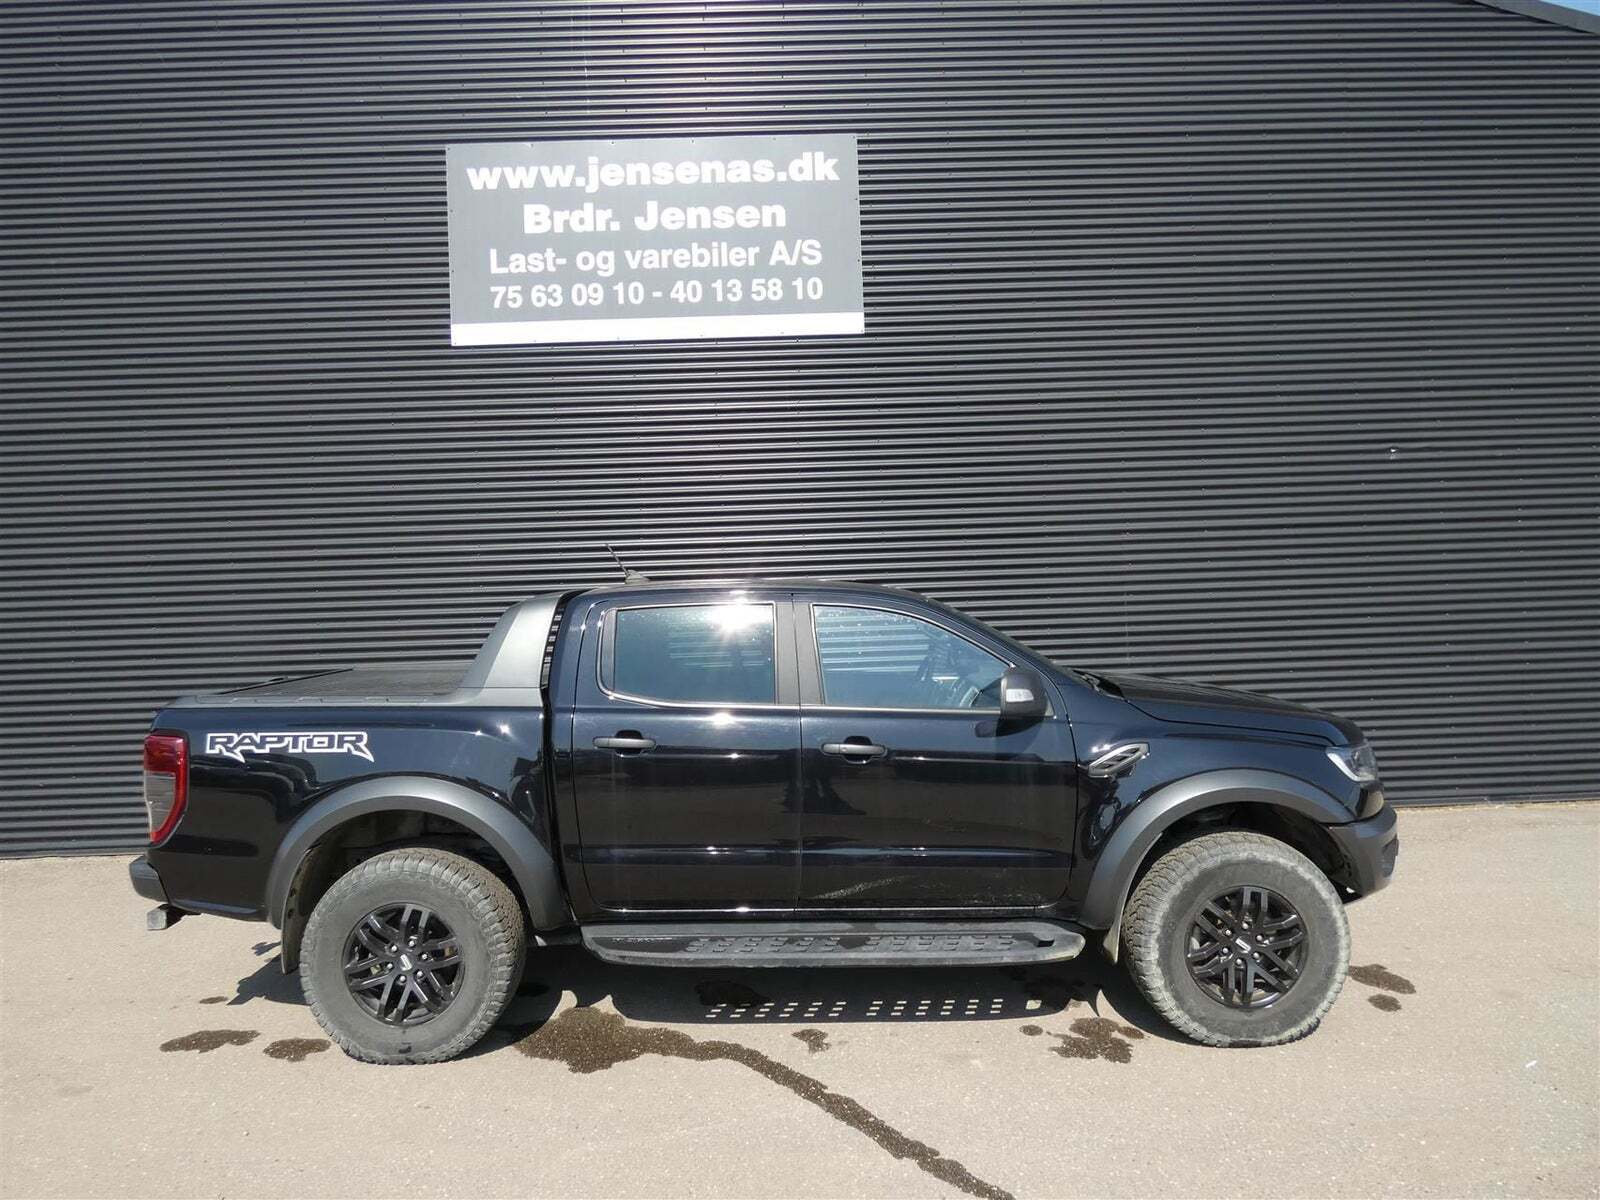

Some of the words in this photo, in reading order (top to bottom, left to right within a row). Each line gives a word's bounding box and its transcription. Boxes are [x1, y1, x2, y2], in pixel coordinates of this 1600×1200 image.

[466, 151, 841, 193] www.jensenas.dk
[523, 202, 621, 234] Brdr.
[634, 200, 787, 231] Jensen
[489, 247, 567, 274] Last-
[575, 251, 616, 277] og
[623, 241, 760, 270] varebiler
[768, 239, 823, 266] A/S
[490, 285, 523, 309] 75
[530, 283, 564, 308] 63
[571, 282, 604, 306] 09
[612, 281, 645, 305] 10
[670, 279, 703, 304] 40
[711, 278, 743, 303] 13
[750, 277, 784, 302] 58
[791, 276, 824, 301] 10
[205, 731, 375, 763] RAPTOR
